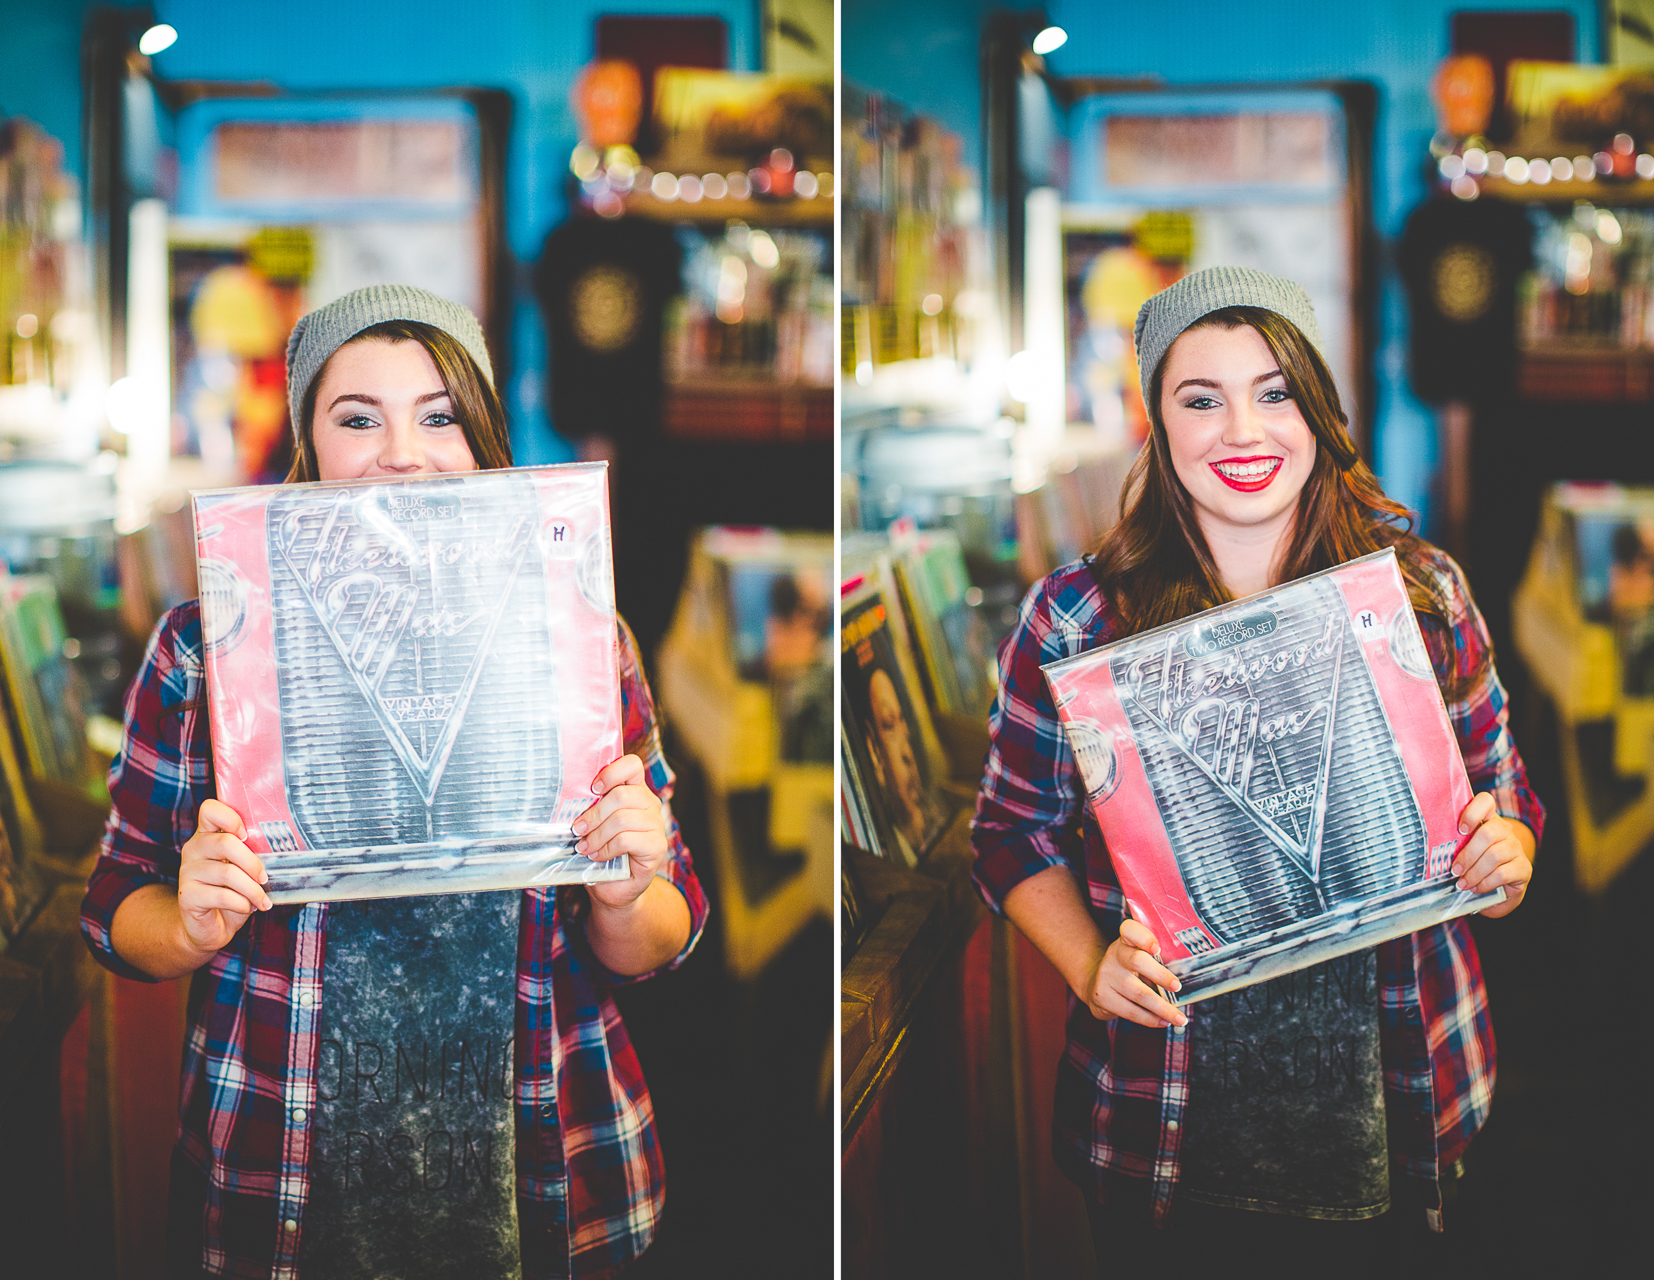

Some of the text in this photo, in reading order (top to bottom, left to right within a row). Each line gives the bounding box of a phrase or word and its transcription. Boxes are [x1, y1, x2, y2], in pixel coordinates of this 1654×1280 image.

[387, 495, 426, 510] DELUXE
[391, 507, 435, 521] RECORD
[437, 505, 456, 518] SET
[553, 525, 565, 542] H
[322, 573, 484, 685] Mac
[1211, 619, 1247, 639] DELUXE
[1361, 613, 1372, 628] H
[1190, 620, 1275, 657] TWO RECORD SET
[382, 694, 454, 711] VINTAGE
[1179, 697, 1318, 798] Mac
[1253, 783, 1315, 812] VINTAGE
